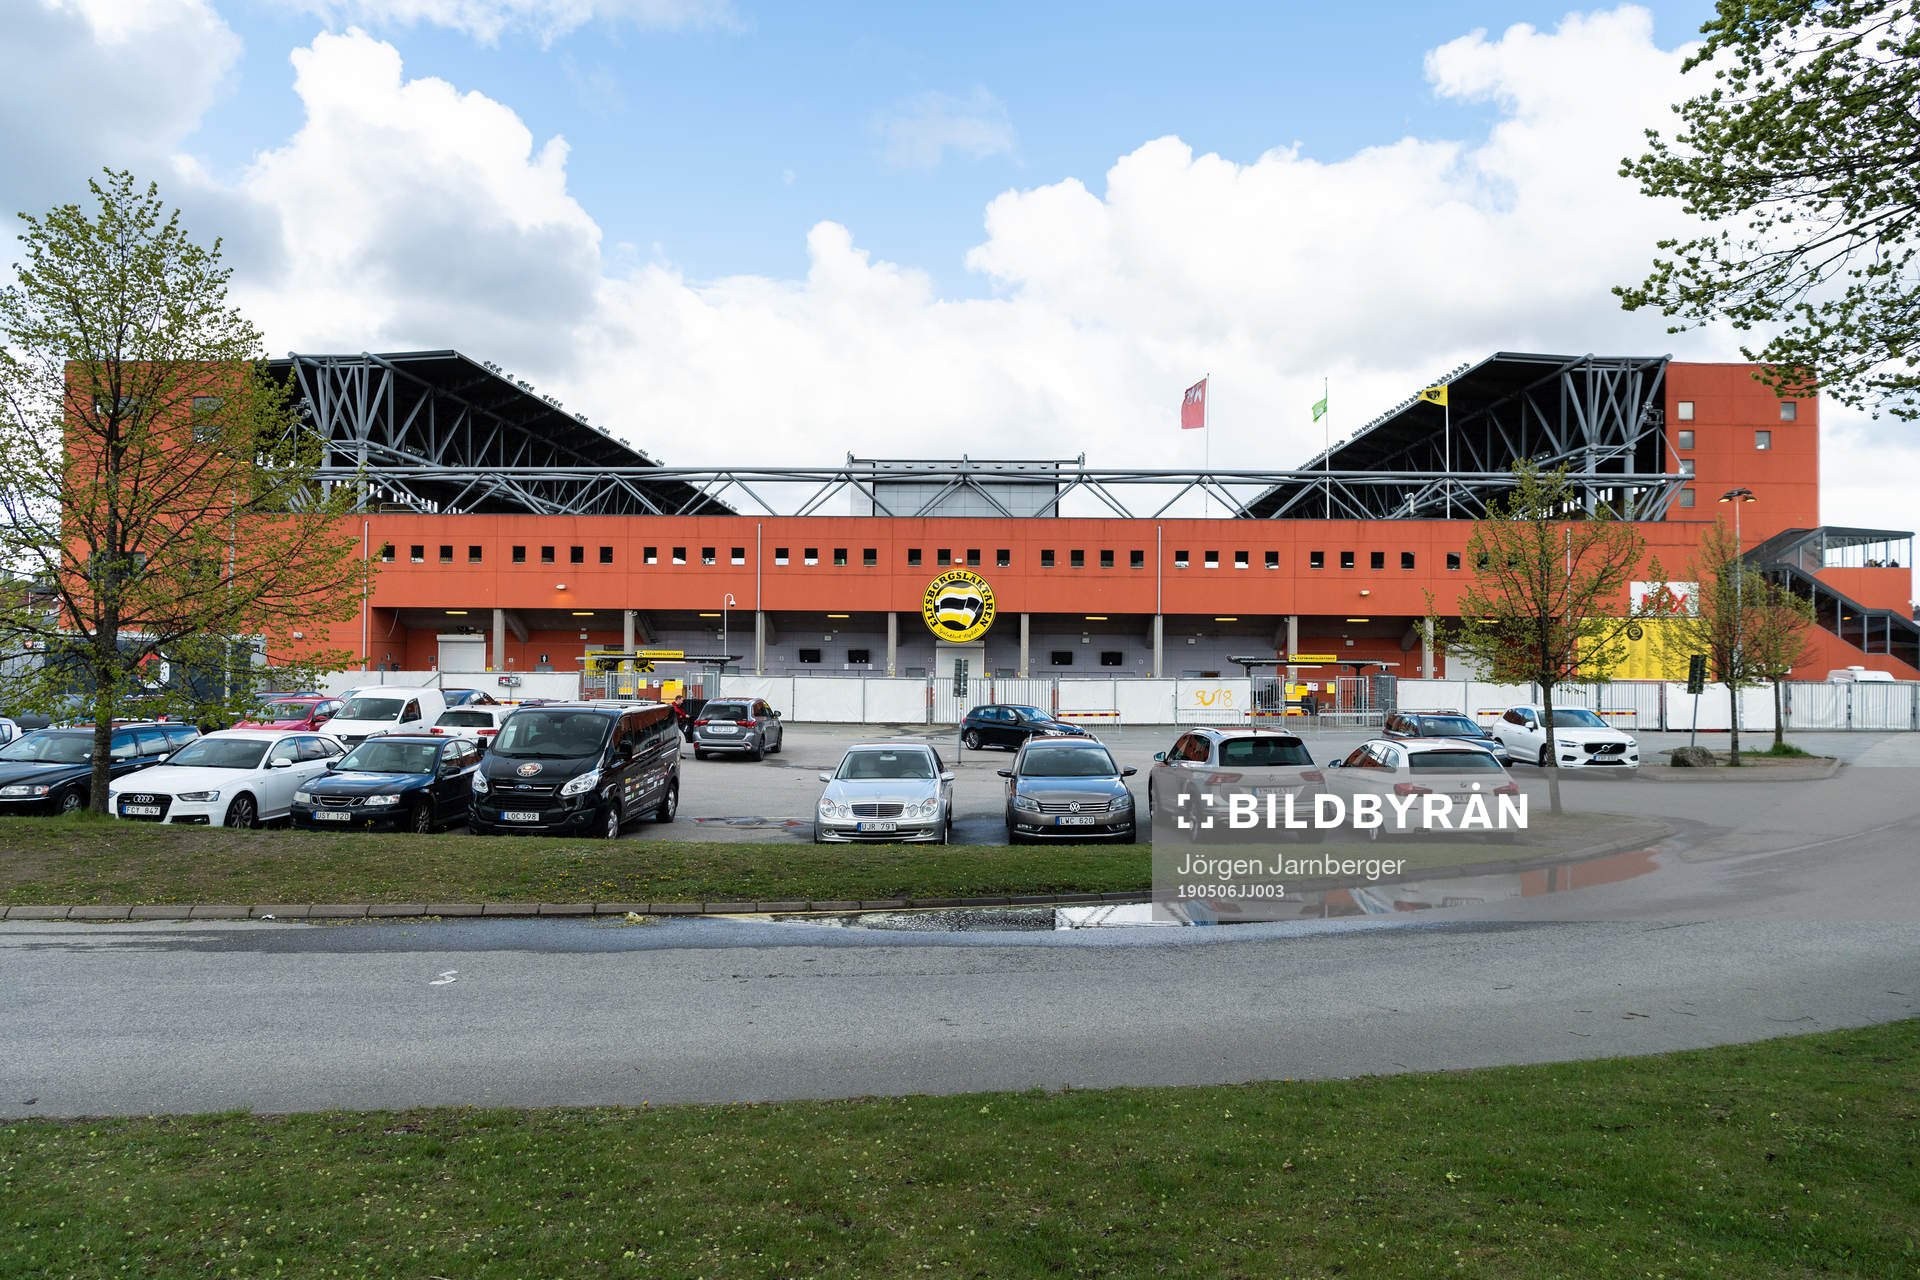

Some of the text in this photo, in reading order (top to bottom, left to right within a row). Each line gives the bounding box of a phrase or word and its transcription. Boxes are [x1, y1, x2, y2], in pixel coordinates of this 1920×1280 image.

[925, 571, 993, 627] ELFSBORGSLÄKTAREN
[336, 812, 350, 820] 120
[862, 822, 895, 830] UJR 791
